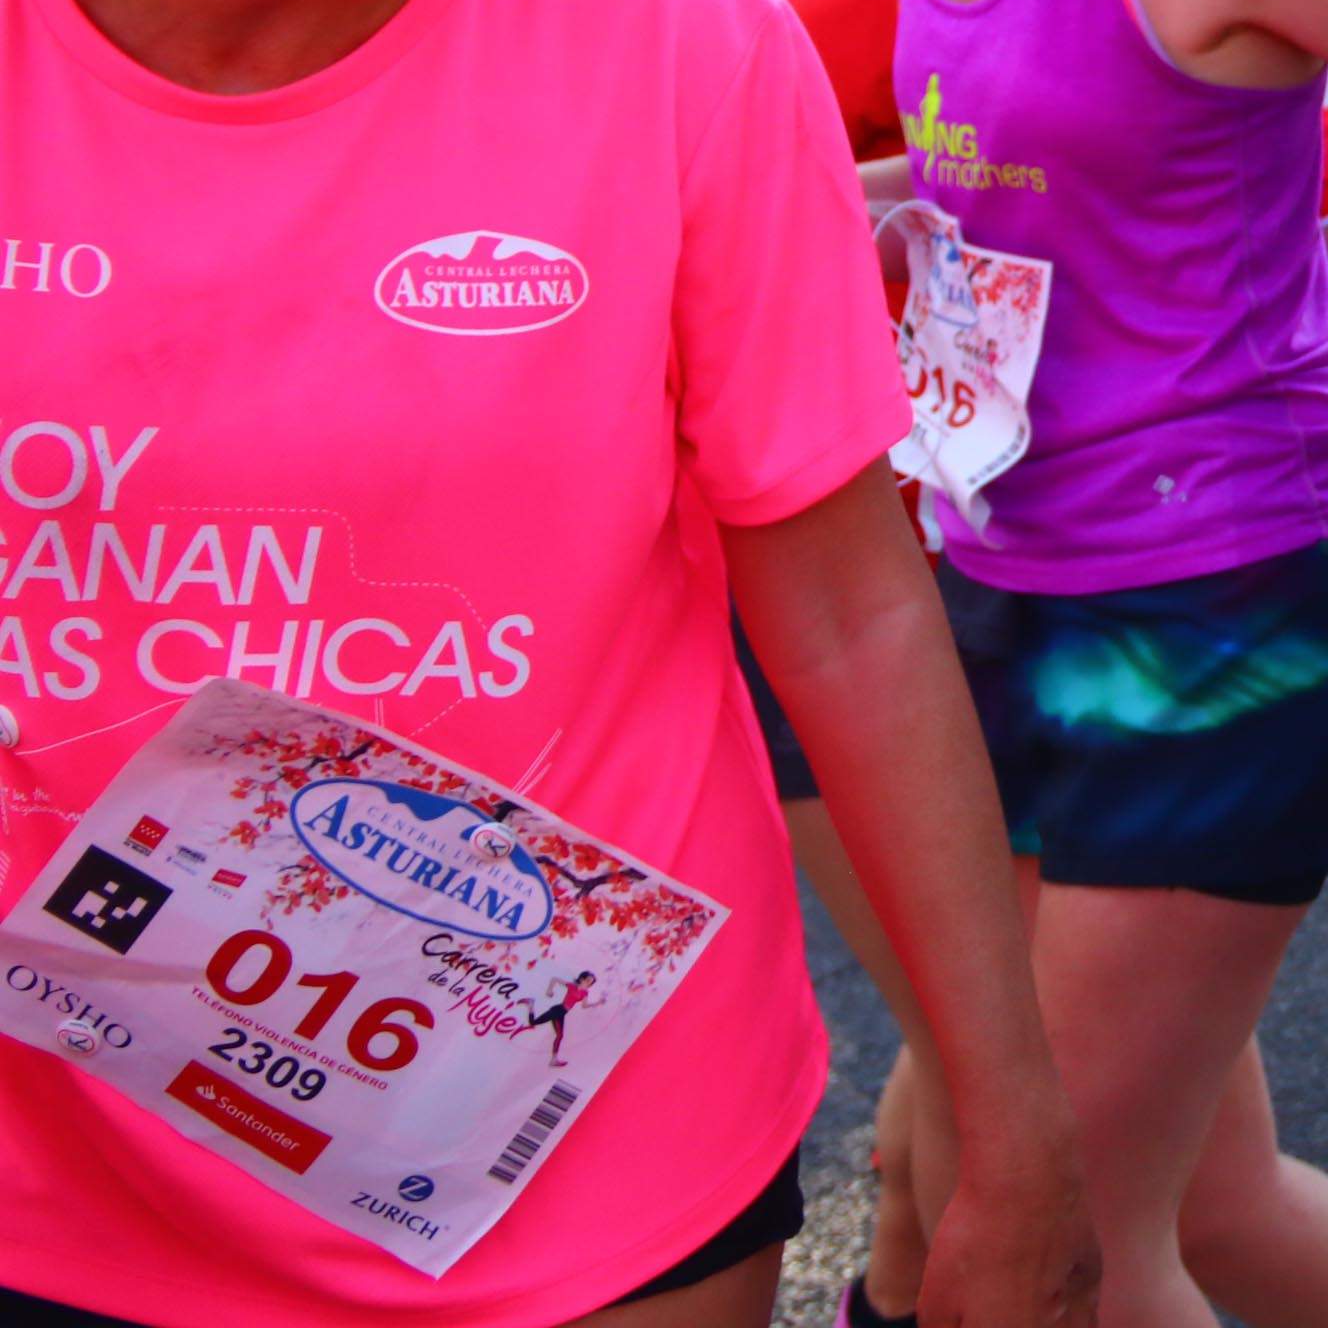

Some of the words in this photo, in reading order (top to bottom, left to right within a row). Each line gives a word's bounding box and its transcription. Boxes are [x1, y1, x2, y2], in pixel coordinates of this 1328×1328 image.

[0, 239, 113, 299] HO
[389, 267, 575, 309] ASTURIANA
[423, 264, 494, 279] CENTRAL
[499, 264, 572, 277] LECHERA
[135, 612, 536, 700] CHICAS
[303, 793, 529, 933] ASTURIANA
[420, 932, 522, 1000] Carrera
[427, 969, 448, 989] de
[447, 976, 466, 998] la
[6, 962, 134, 1051] OYSHO
[205, 928, 437, 1073] 016
[446, 985, 536, 1042] Mujer
[207, 1027, 327, 1102] 2309
[254, 1024, 318, 1060] VIOLENCIA
[318, 1054, 338, 1068] DE
[213, 1094, 302, 1155] Santander
[350, 1190, 440, 1241] ZURICH
